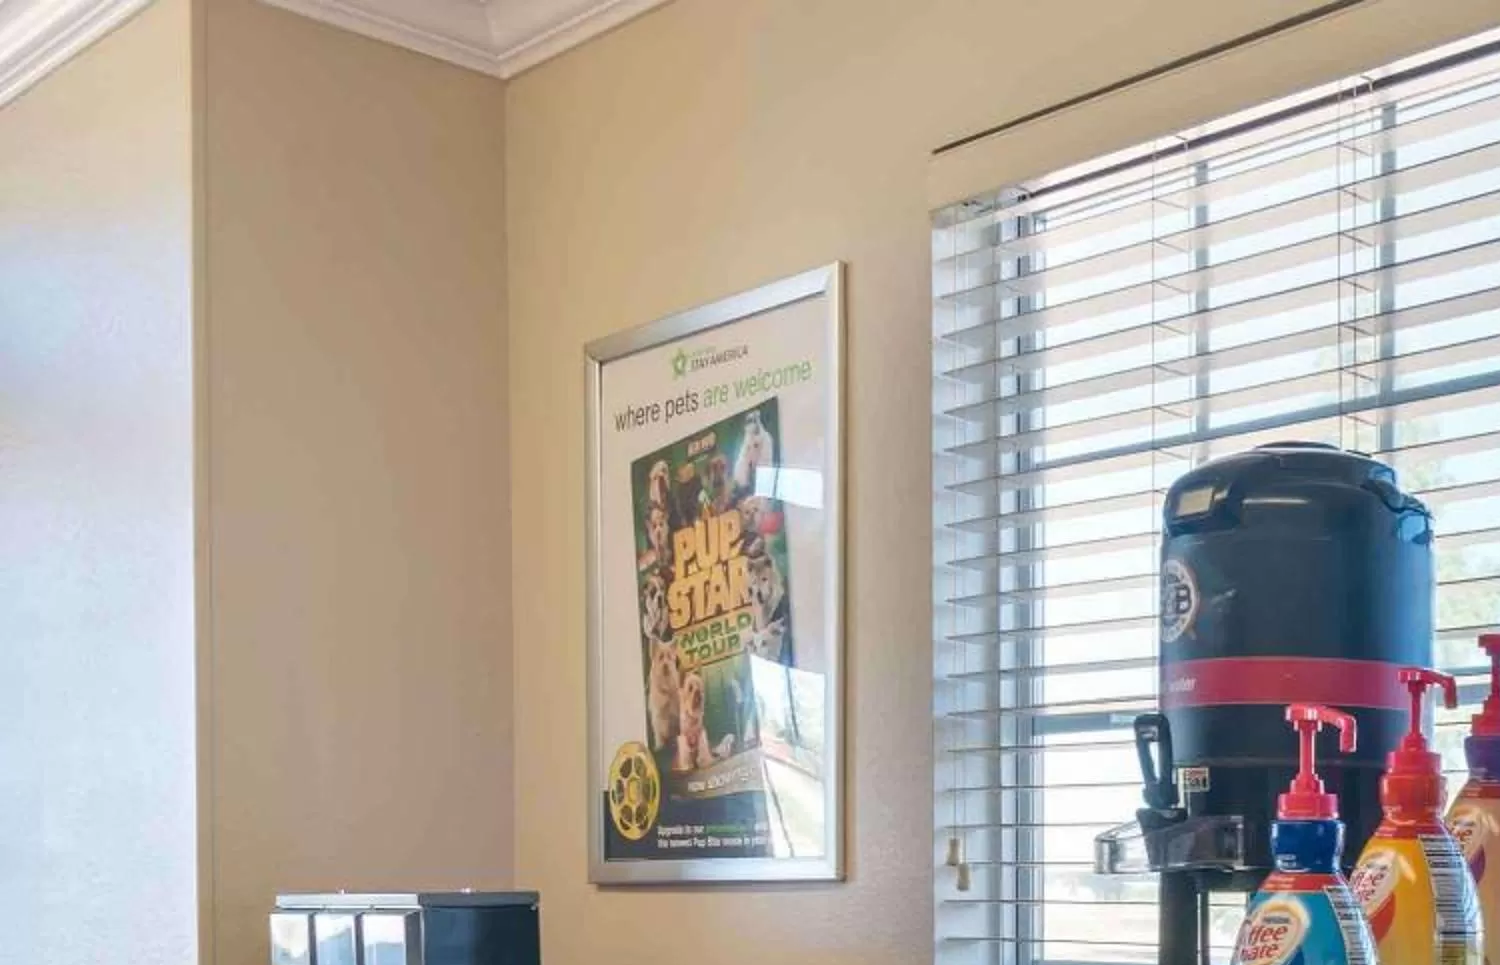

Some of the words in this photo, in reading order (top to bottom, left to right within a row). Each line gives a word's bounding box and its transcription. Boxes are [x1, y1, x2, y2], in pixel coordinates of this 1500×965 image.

[615, 400, 661, 433] where
[665, 389, 700, 423] pets
[703, 385, 730, 407] are
[734, 360, 812, 398] welcome
[673, 509, 743, 577] PUP
[667, 555, 753, 629] STAR
[680, 612, 751, 648] WORLD
[683, 633, 741, 660] TOUR
